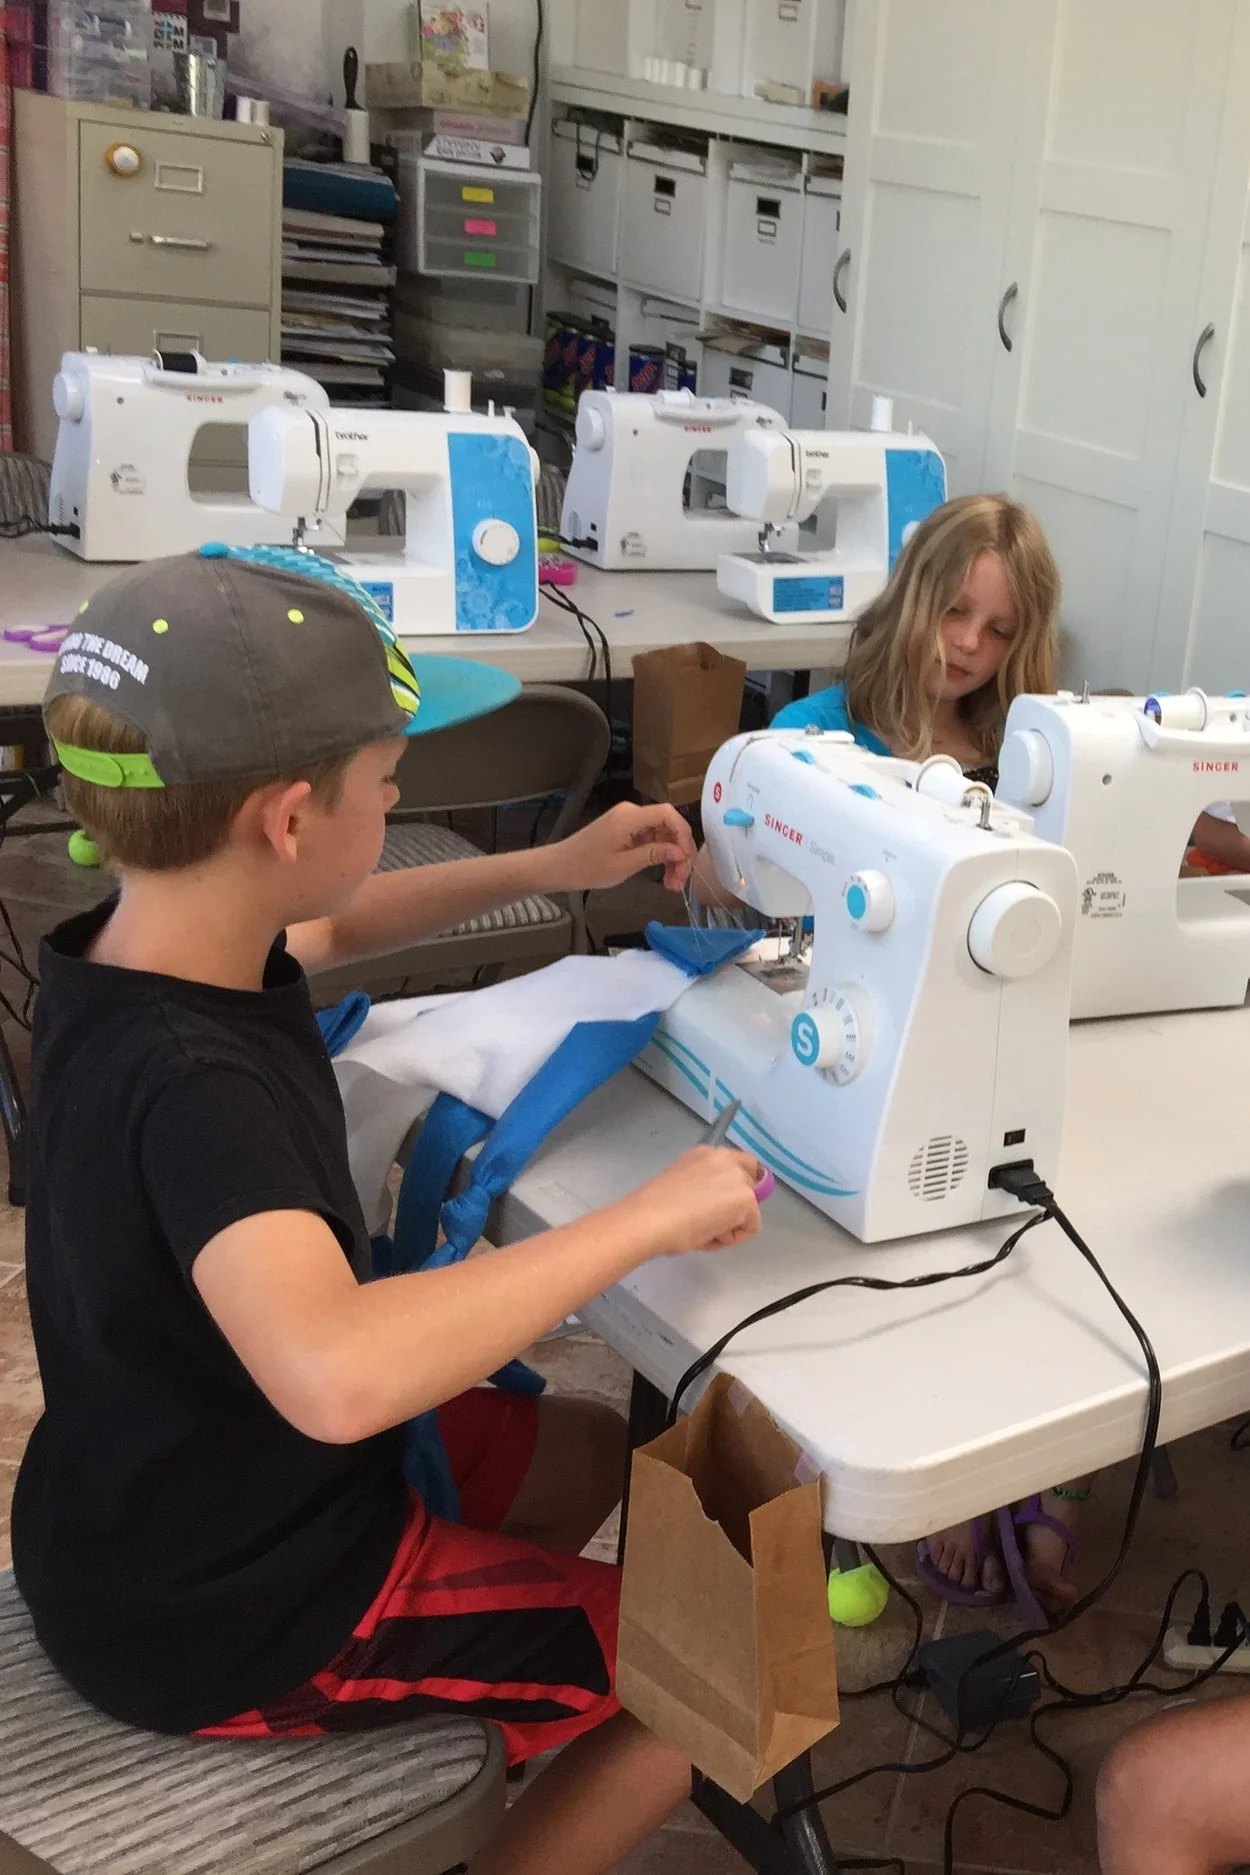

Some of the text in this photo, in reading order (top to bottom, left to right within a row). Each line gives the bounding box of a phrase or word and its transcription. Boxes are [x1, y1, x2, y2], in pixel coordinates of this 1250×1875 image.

[102, 640, 149, 685] DREAM
[1192, 761, 1239, 772] SINGER
[765, 813, 804, 846] SINGER
[797, 1021, 813, 1057] S
